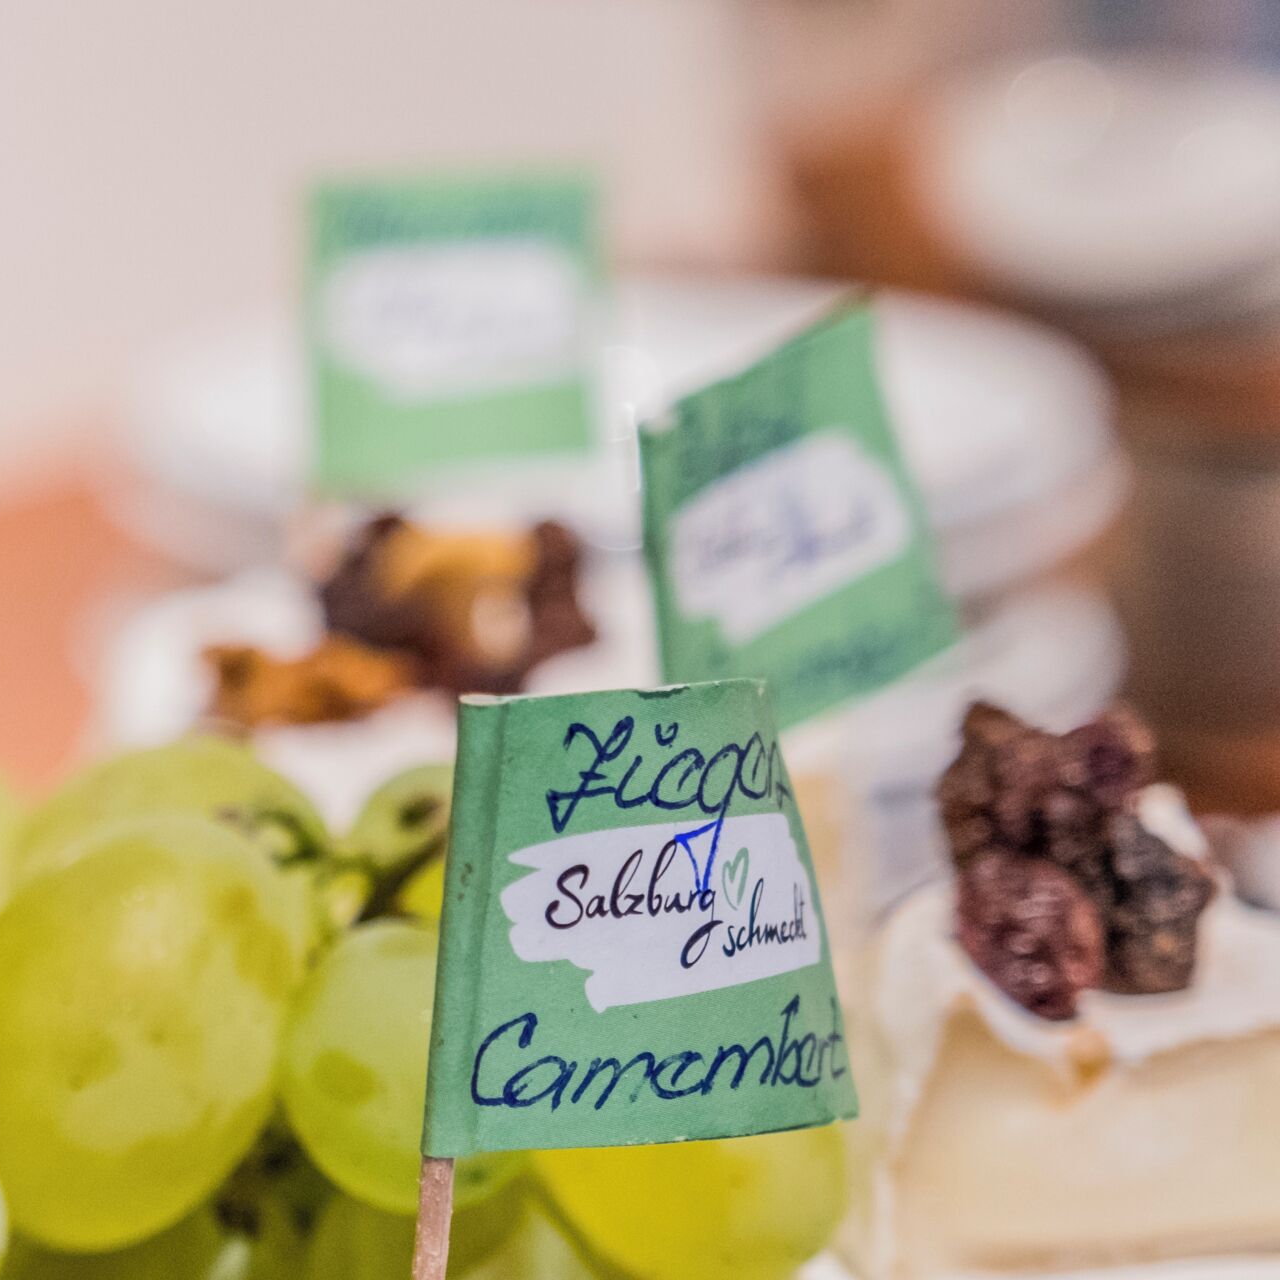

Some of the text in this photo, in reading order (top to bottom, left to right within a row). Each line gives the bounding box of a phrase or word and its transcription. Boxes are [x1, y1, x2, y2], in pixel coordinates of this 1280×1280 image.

[545, 839, 807, 969] Salzburg schmeckt
[471, 992, 847, 1112] Camembert
